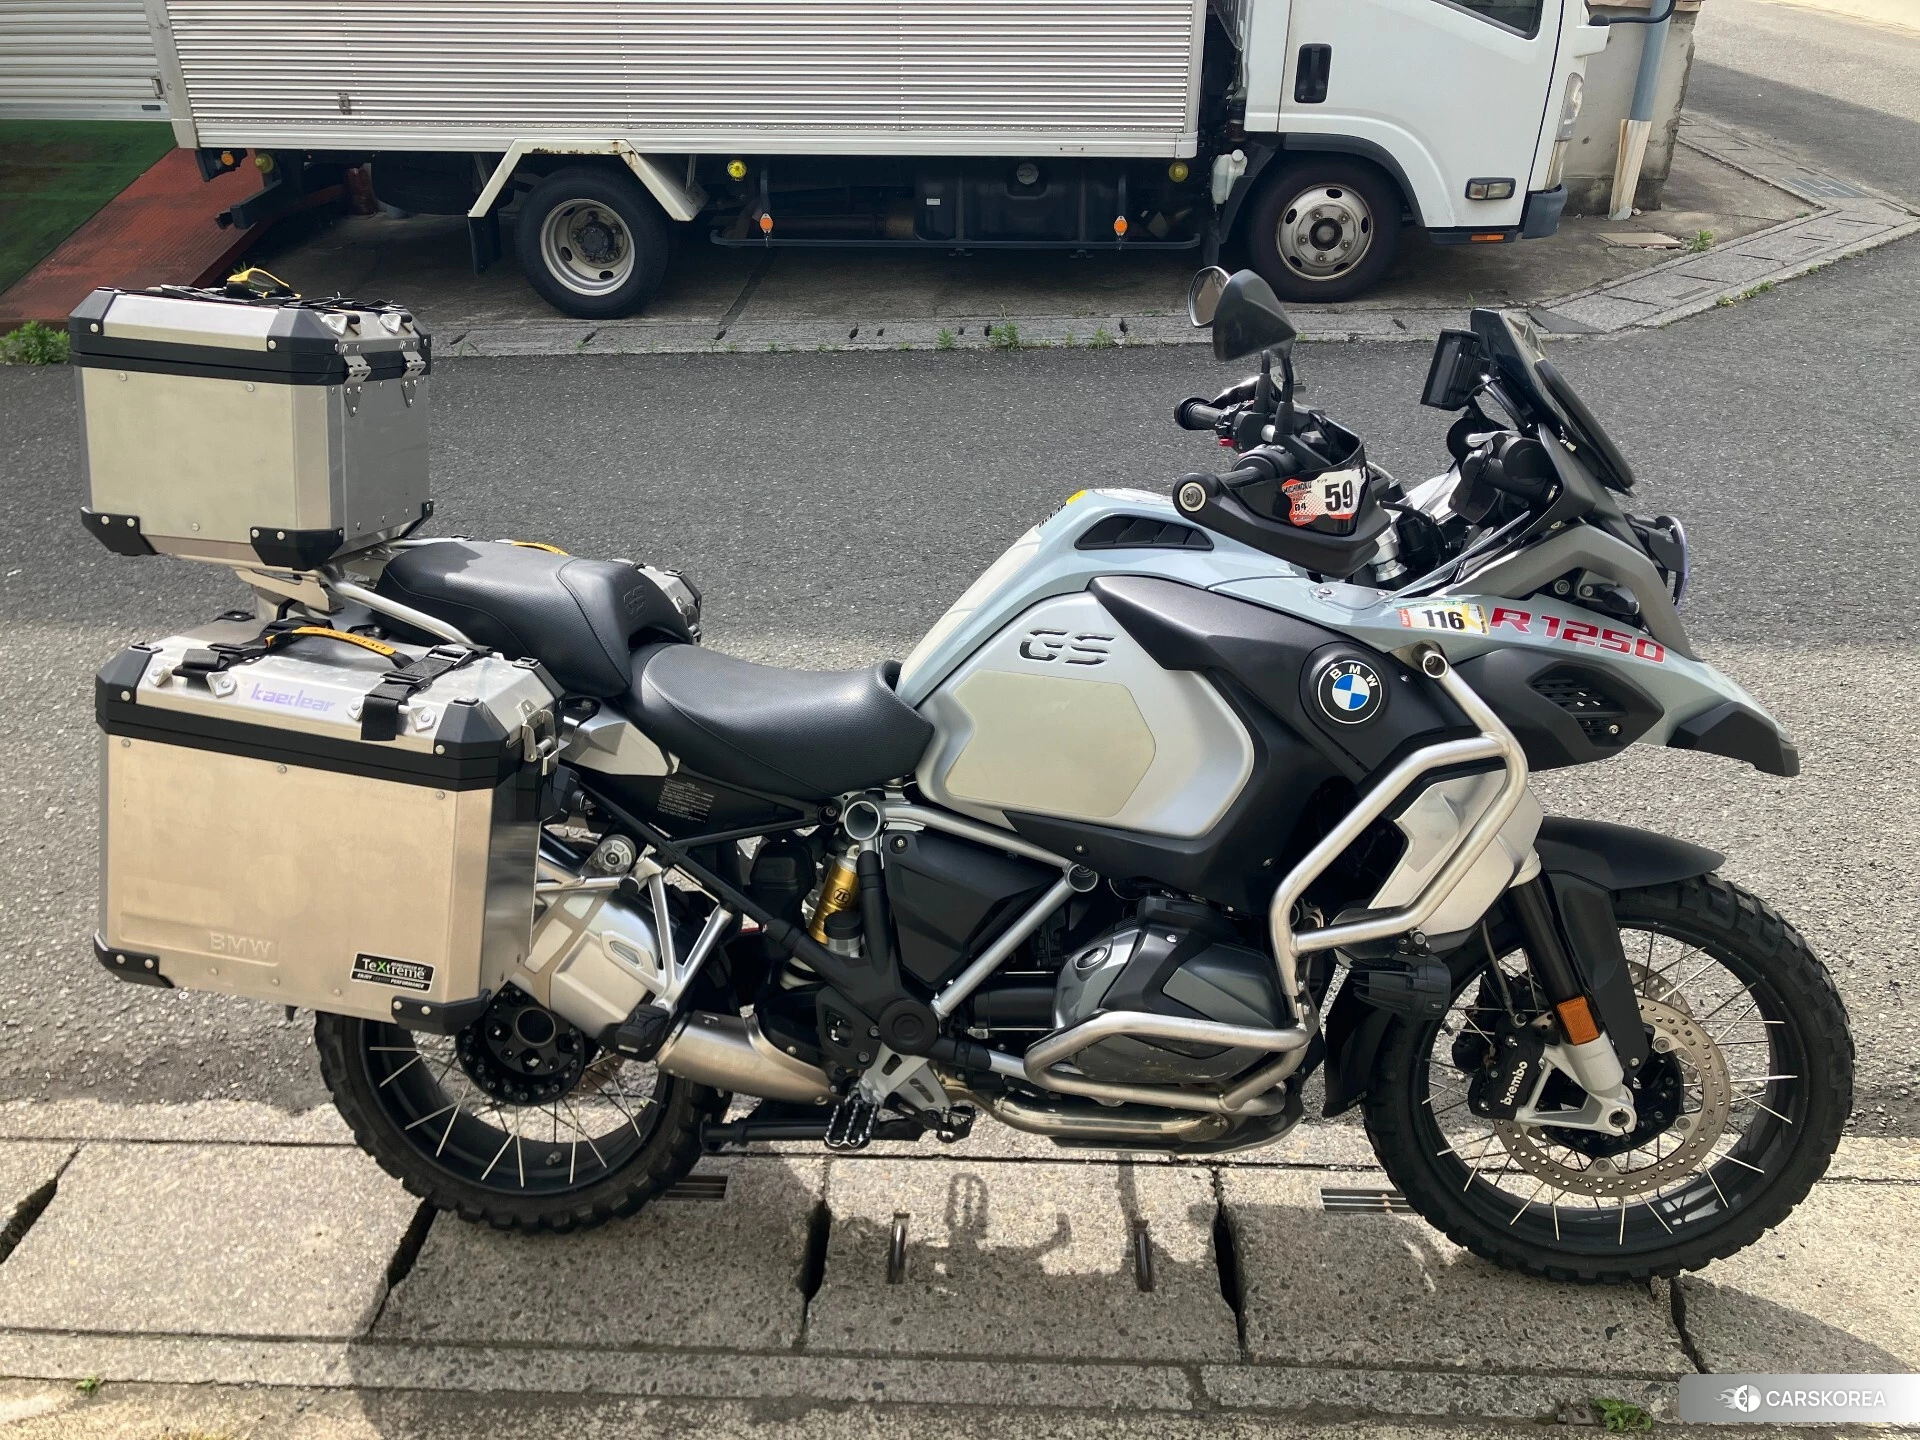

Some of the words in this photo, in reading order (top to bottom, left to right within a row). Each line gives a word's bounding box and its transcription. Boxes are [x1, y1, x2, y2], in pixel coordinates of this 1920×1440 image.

[1325, 480, 1353, 512] 59
[1422, 609, 1465, 631] 116
[1019, 629, 1115, 666] GS
[1489, 607, 1532, 634] R
[1540, 614, 1666, 664] 1250
[1329, 663, 1379, 688] BMW
[209, 930, 273, 959] BMW
[361, 957, 426, 981] TeXtreme
[1500, 1061, 1528, 1106] brembo
